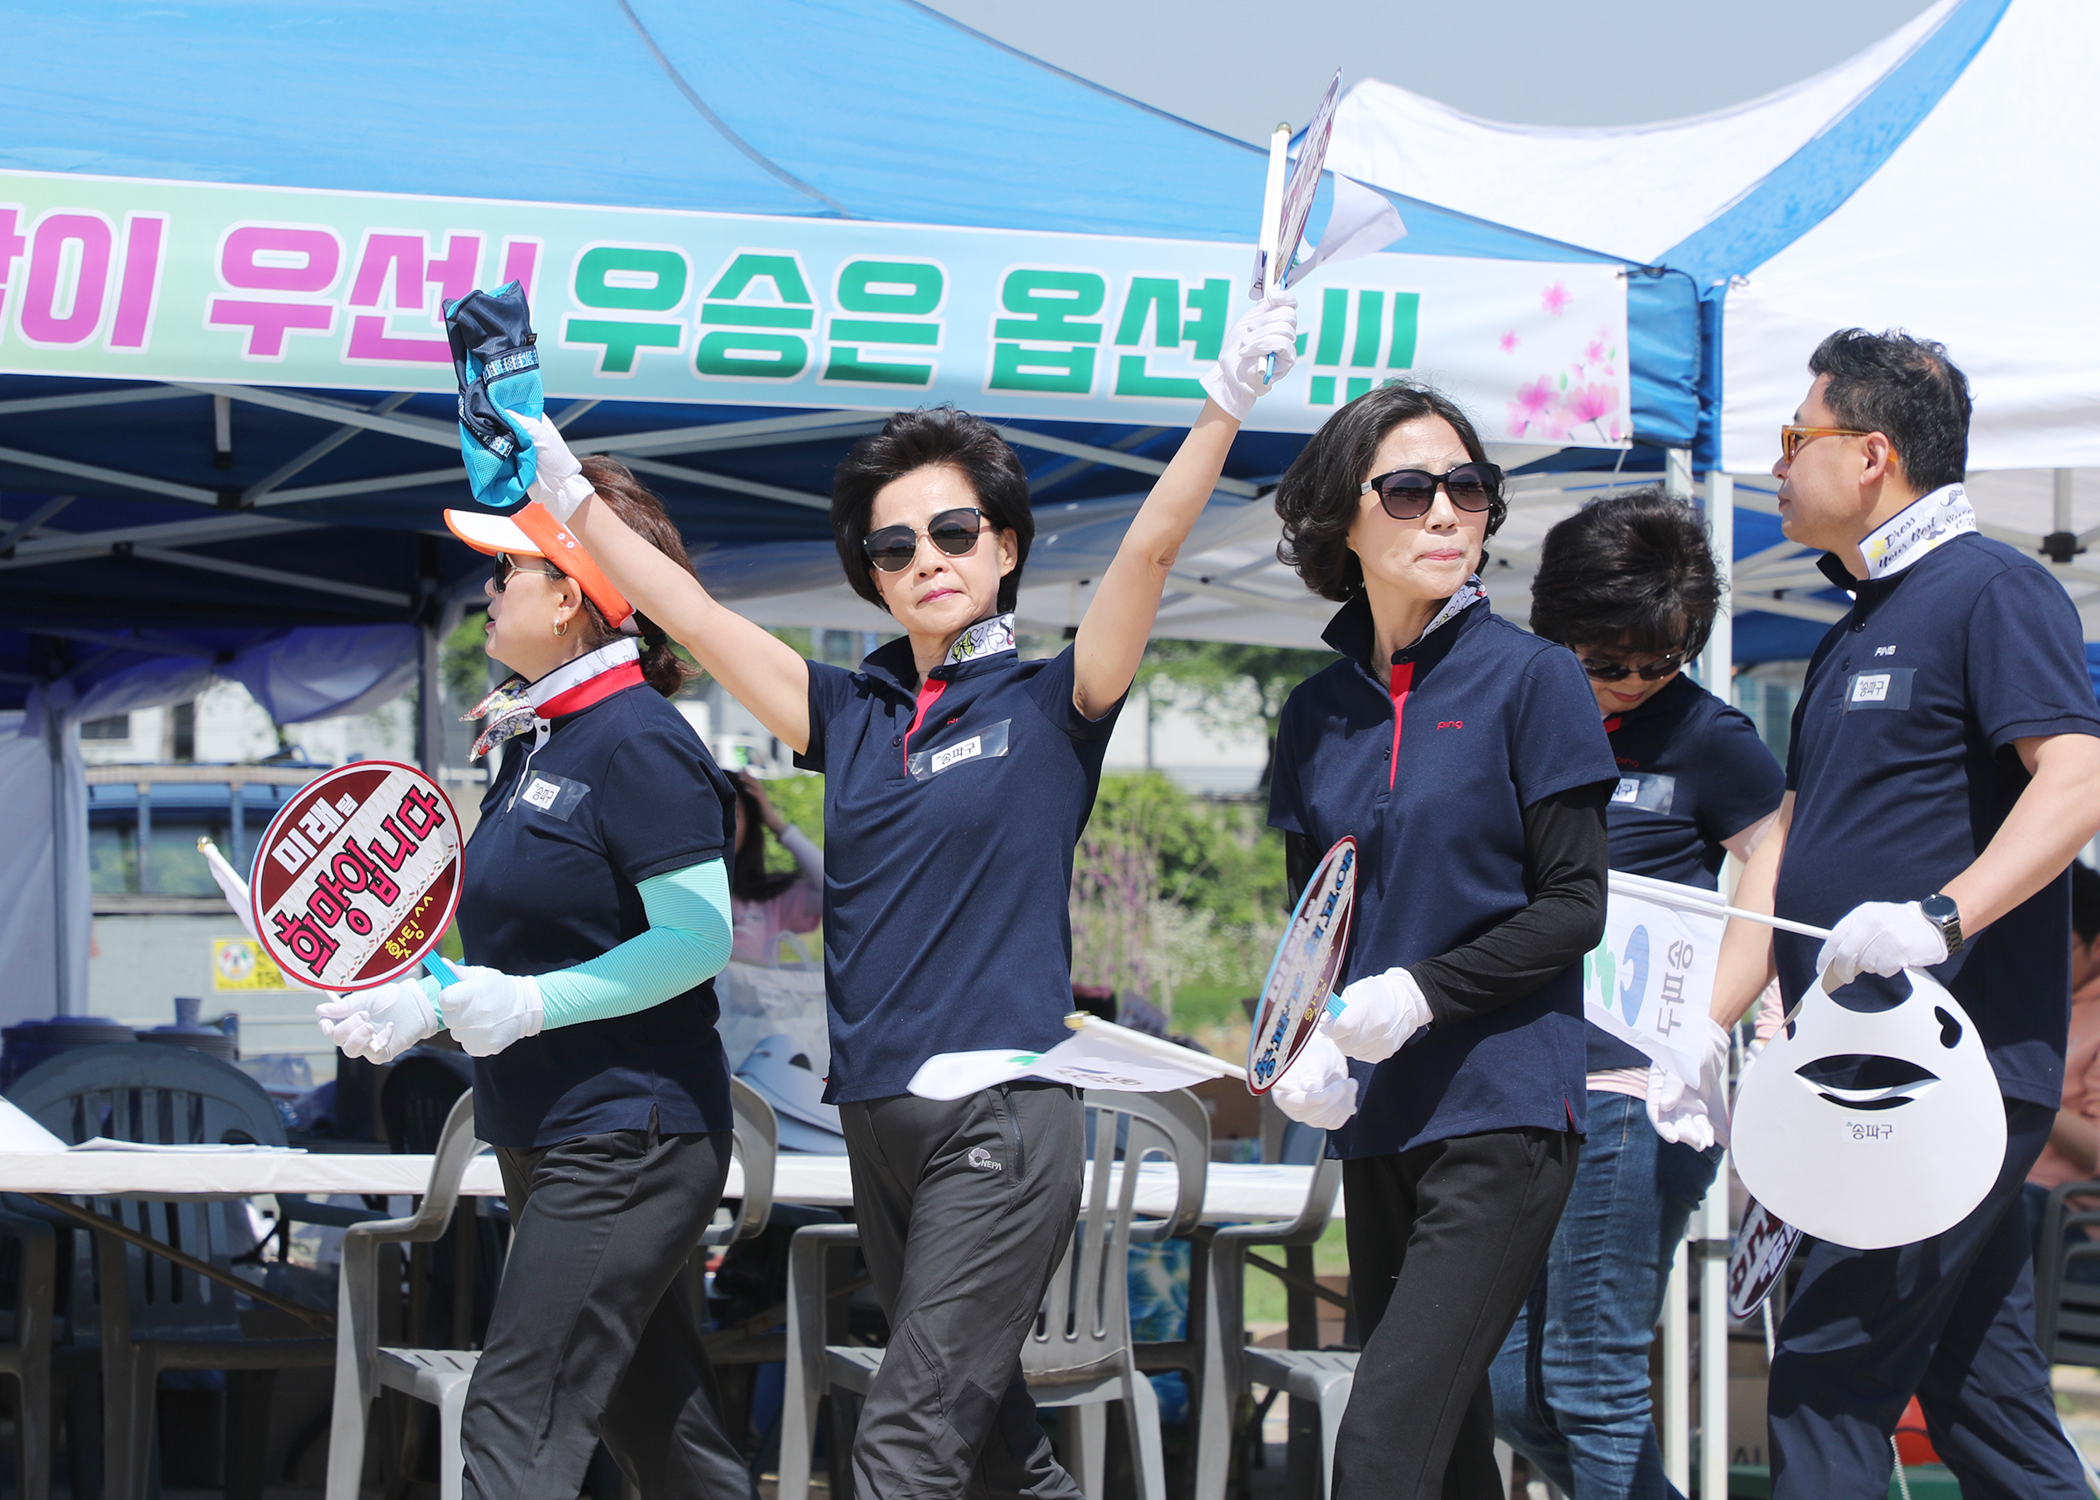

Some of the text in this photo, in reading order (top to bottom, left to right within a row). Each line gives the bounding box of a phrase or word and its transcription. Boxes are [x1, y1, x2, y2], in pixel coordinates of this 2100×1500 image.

[564, 246, 944, 386] 우승은
[987, 269, 1421, 405] 옵션!!!
[1884, 517, 1916, 550] Dress
[1859, 681, 1885, 697] 송파구
[1436, 720, 1464, 731] ping
[941, 742, 976, 765] 송파구
[532, 786, 555, 805] 송파구
[272, 784, 446, 978] 희망입니다
[385, 919, 425, 960] 홧팅
[1851, 1123, 1894, 1140] 송파구
[980, 1159, 1002, 1171] NEPA
